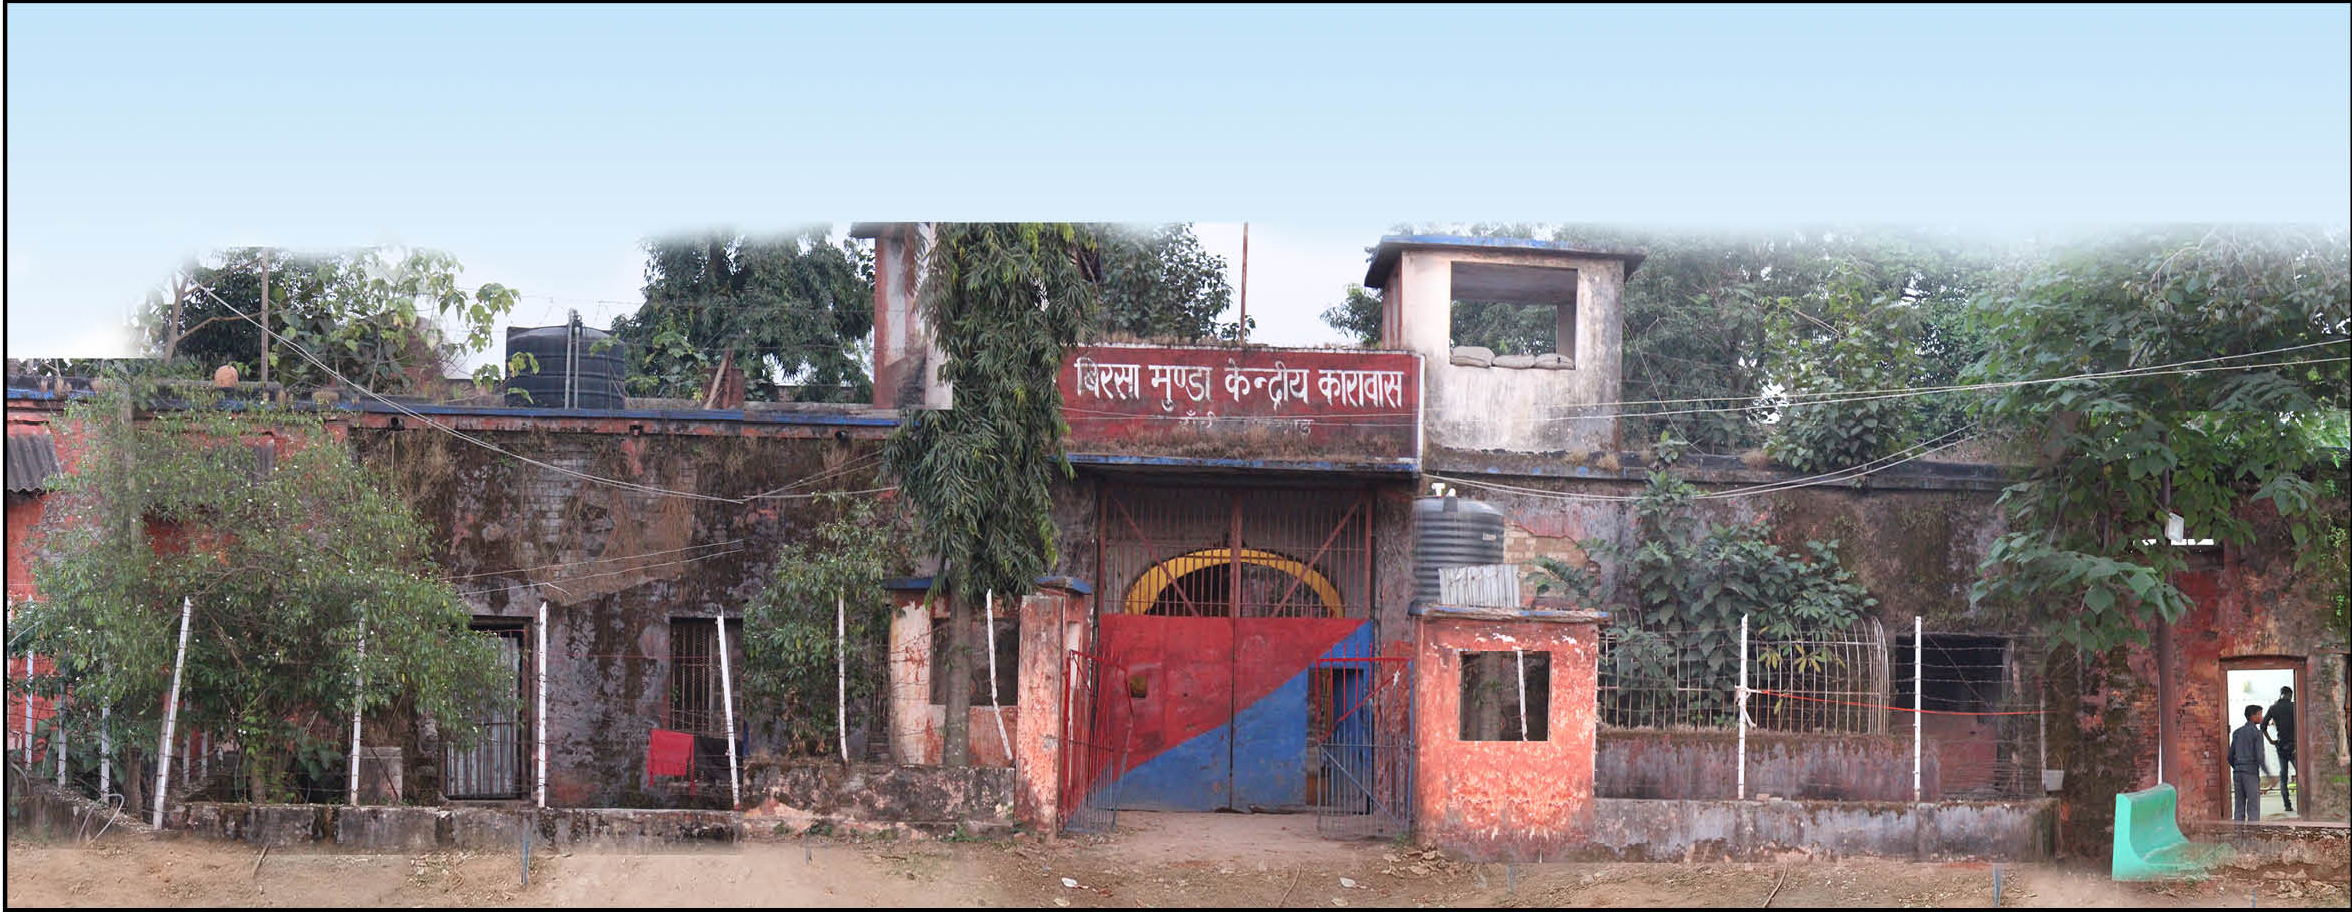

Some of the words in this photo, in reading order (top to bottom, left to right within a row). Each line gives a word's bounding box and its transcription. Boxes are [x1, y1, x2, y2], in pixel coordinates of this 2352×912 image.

[1074, 357, 1141, 399] बिरसा
[1148, 364, 1212, 411] मुण्डा
[1318, 369, 1404, 408] कारावास
